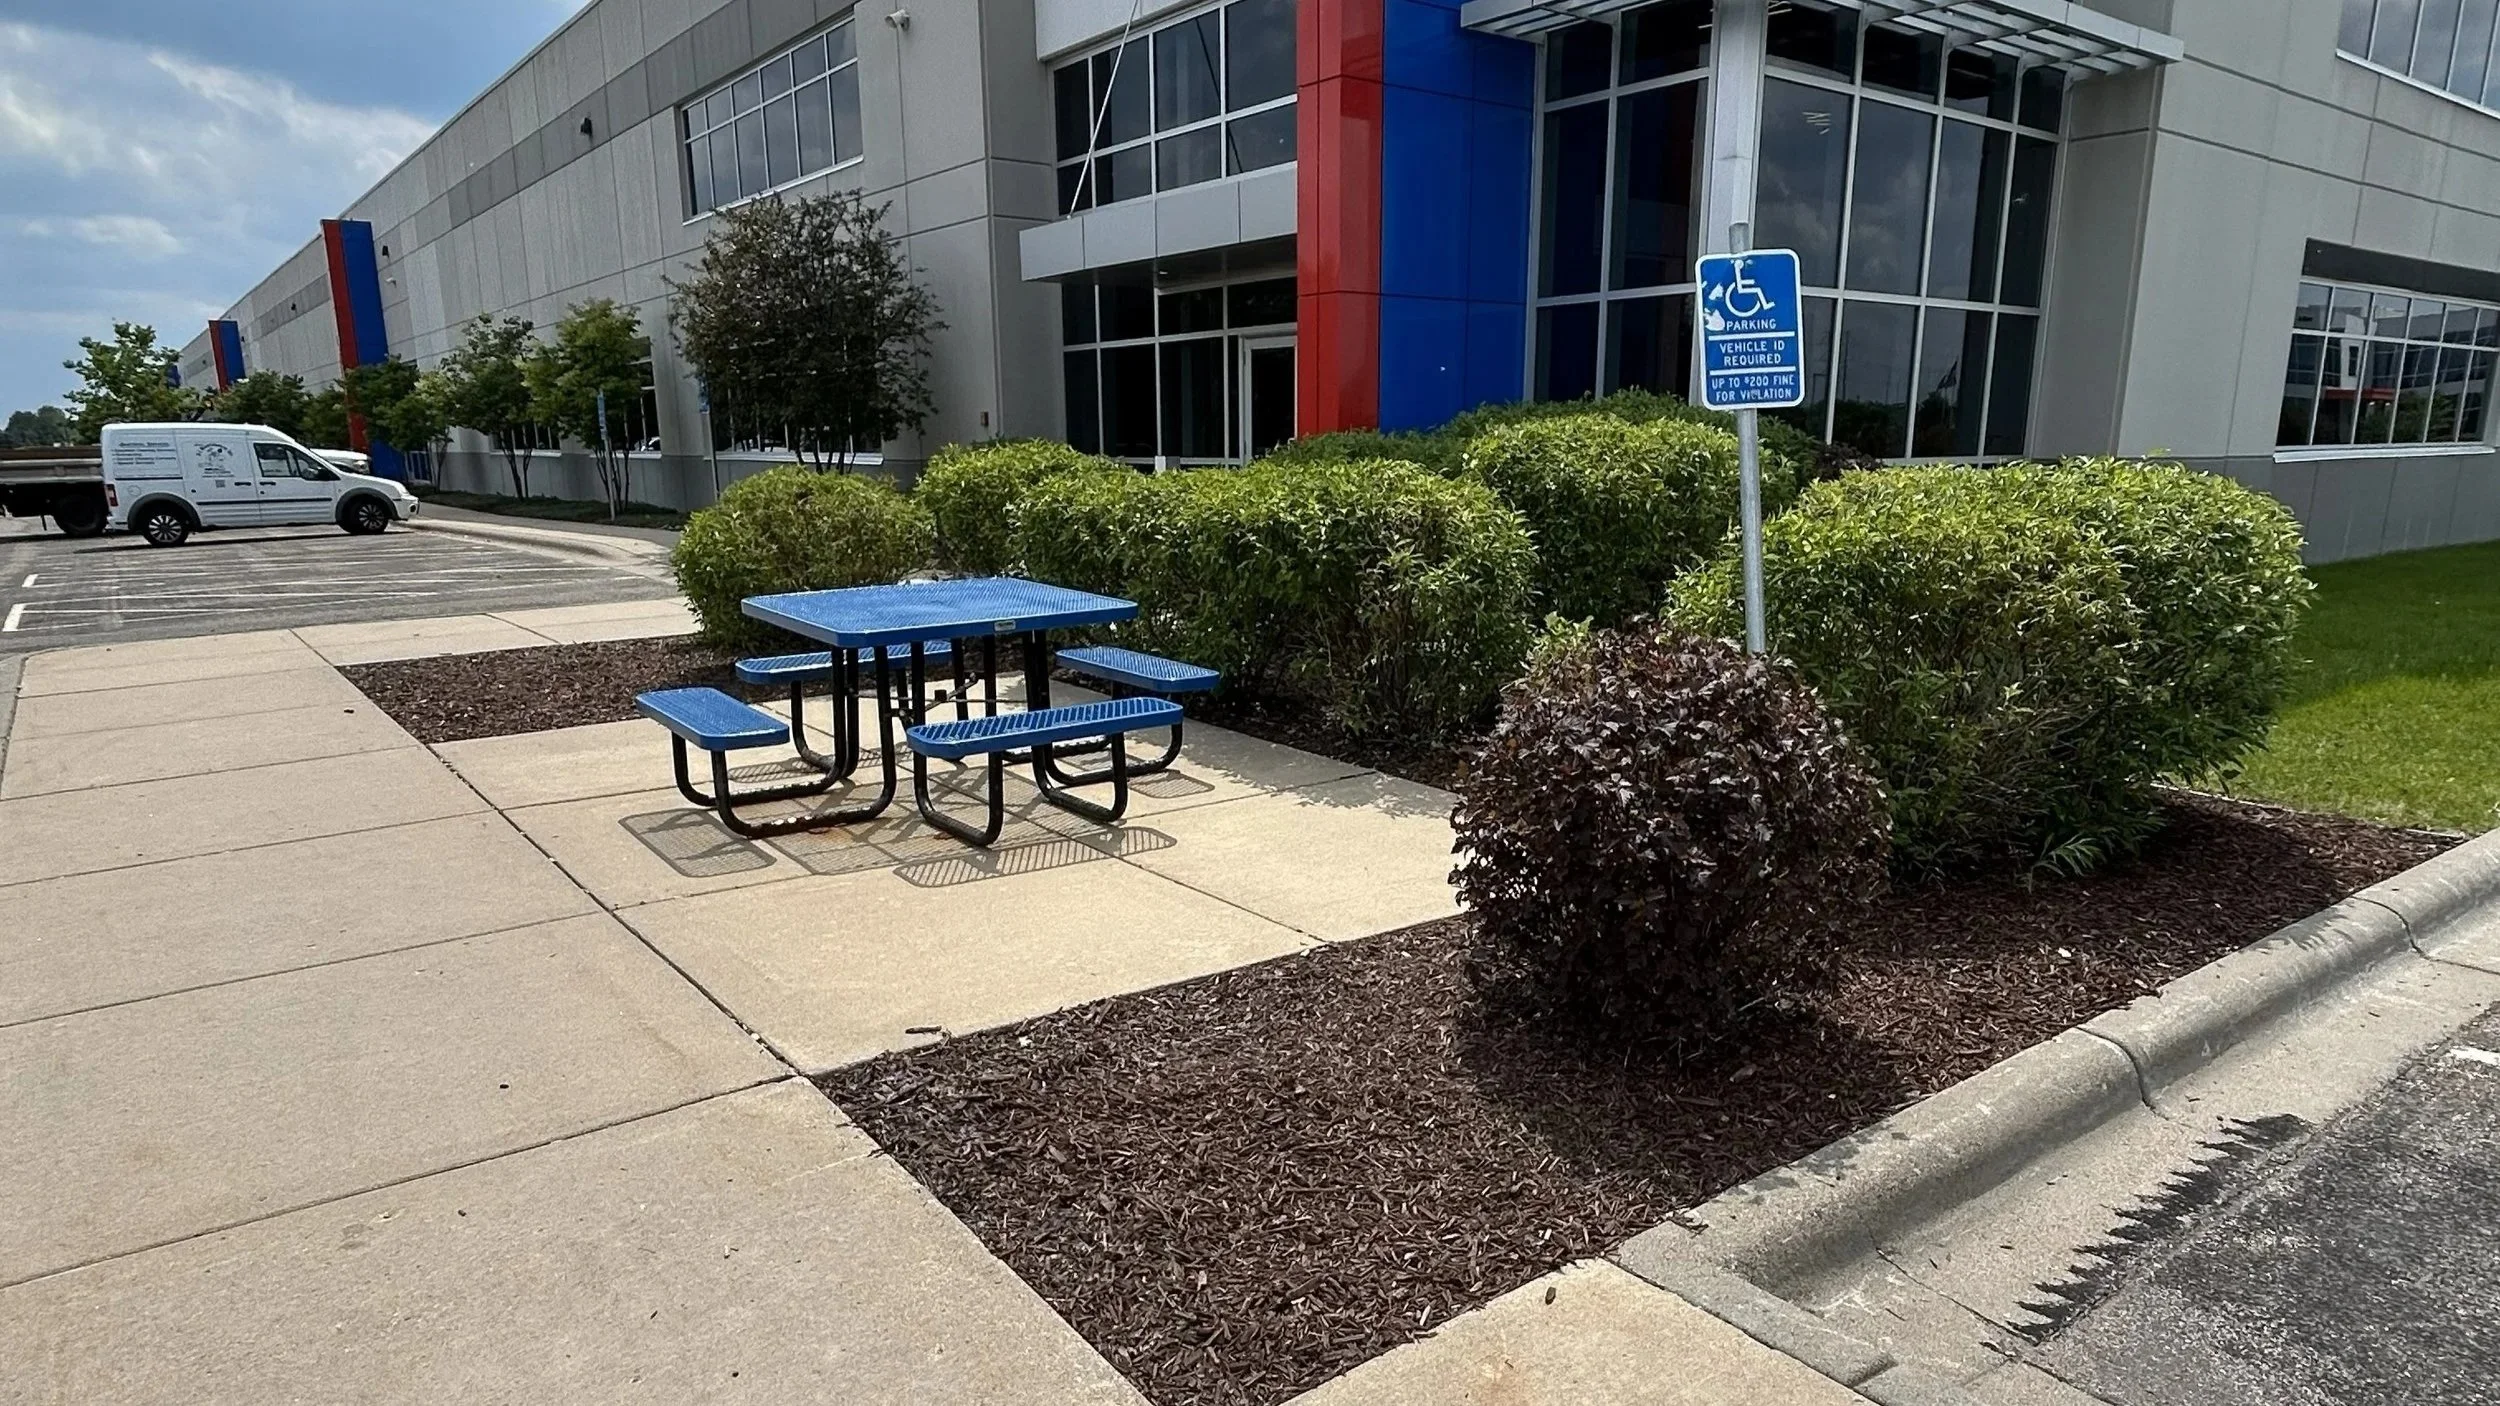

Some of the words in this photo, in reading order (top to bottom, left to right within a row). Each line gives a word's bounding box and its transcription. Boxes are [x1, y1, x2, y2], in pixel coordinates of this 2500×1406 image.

[1726, 319, 1777, 331] PARKING
[1719, 341, 1767, 353] VEHICLE
[1774, 340, 1785, 351] ID
[1724, 354, 1781, 366] REQUIRED
[1711, 378, 1726, 390] UP
[1729, 377, 1740, 388] TO
[1744, 376, 1769, 387] $200
[1773, 375, 1795, 386] FINE
[1716, 391, 1736, 402] FOR
